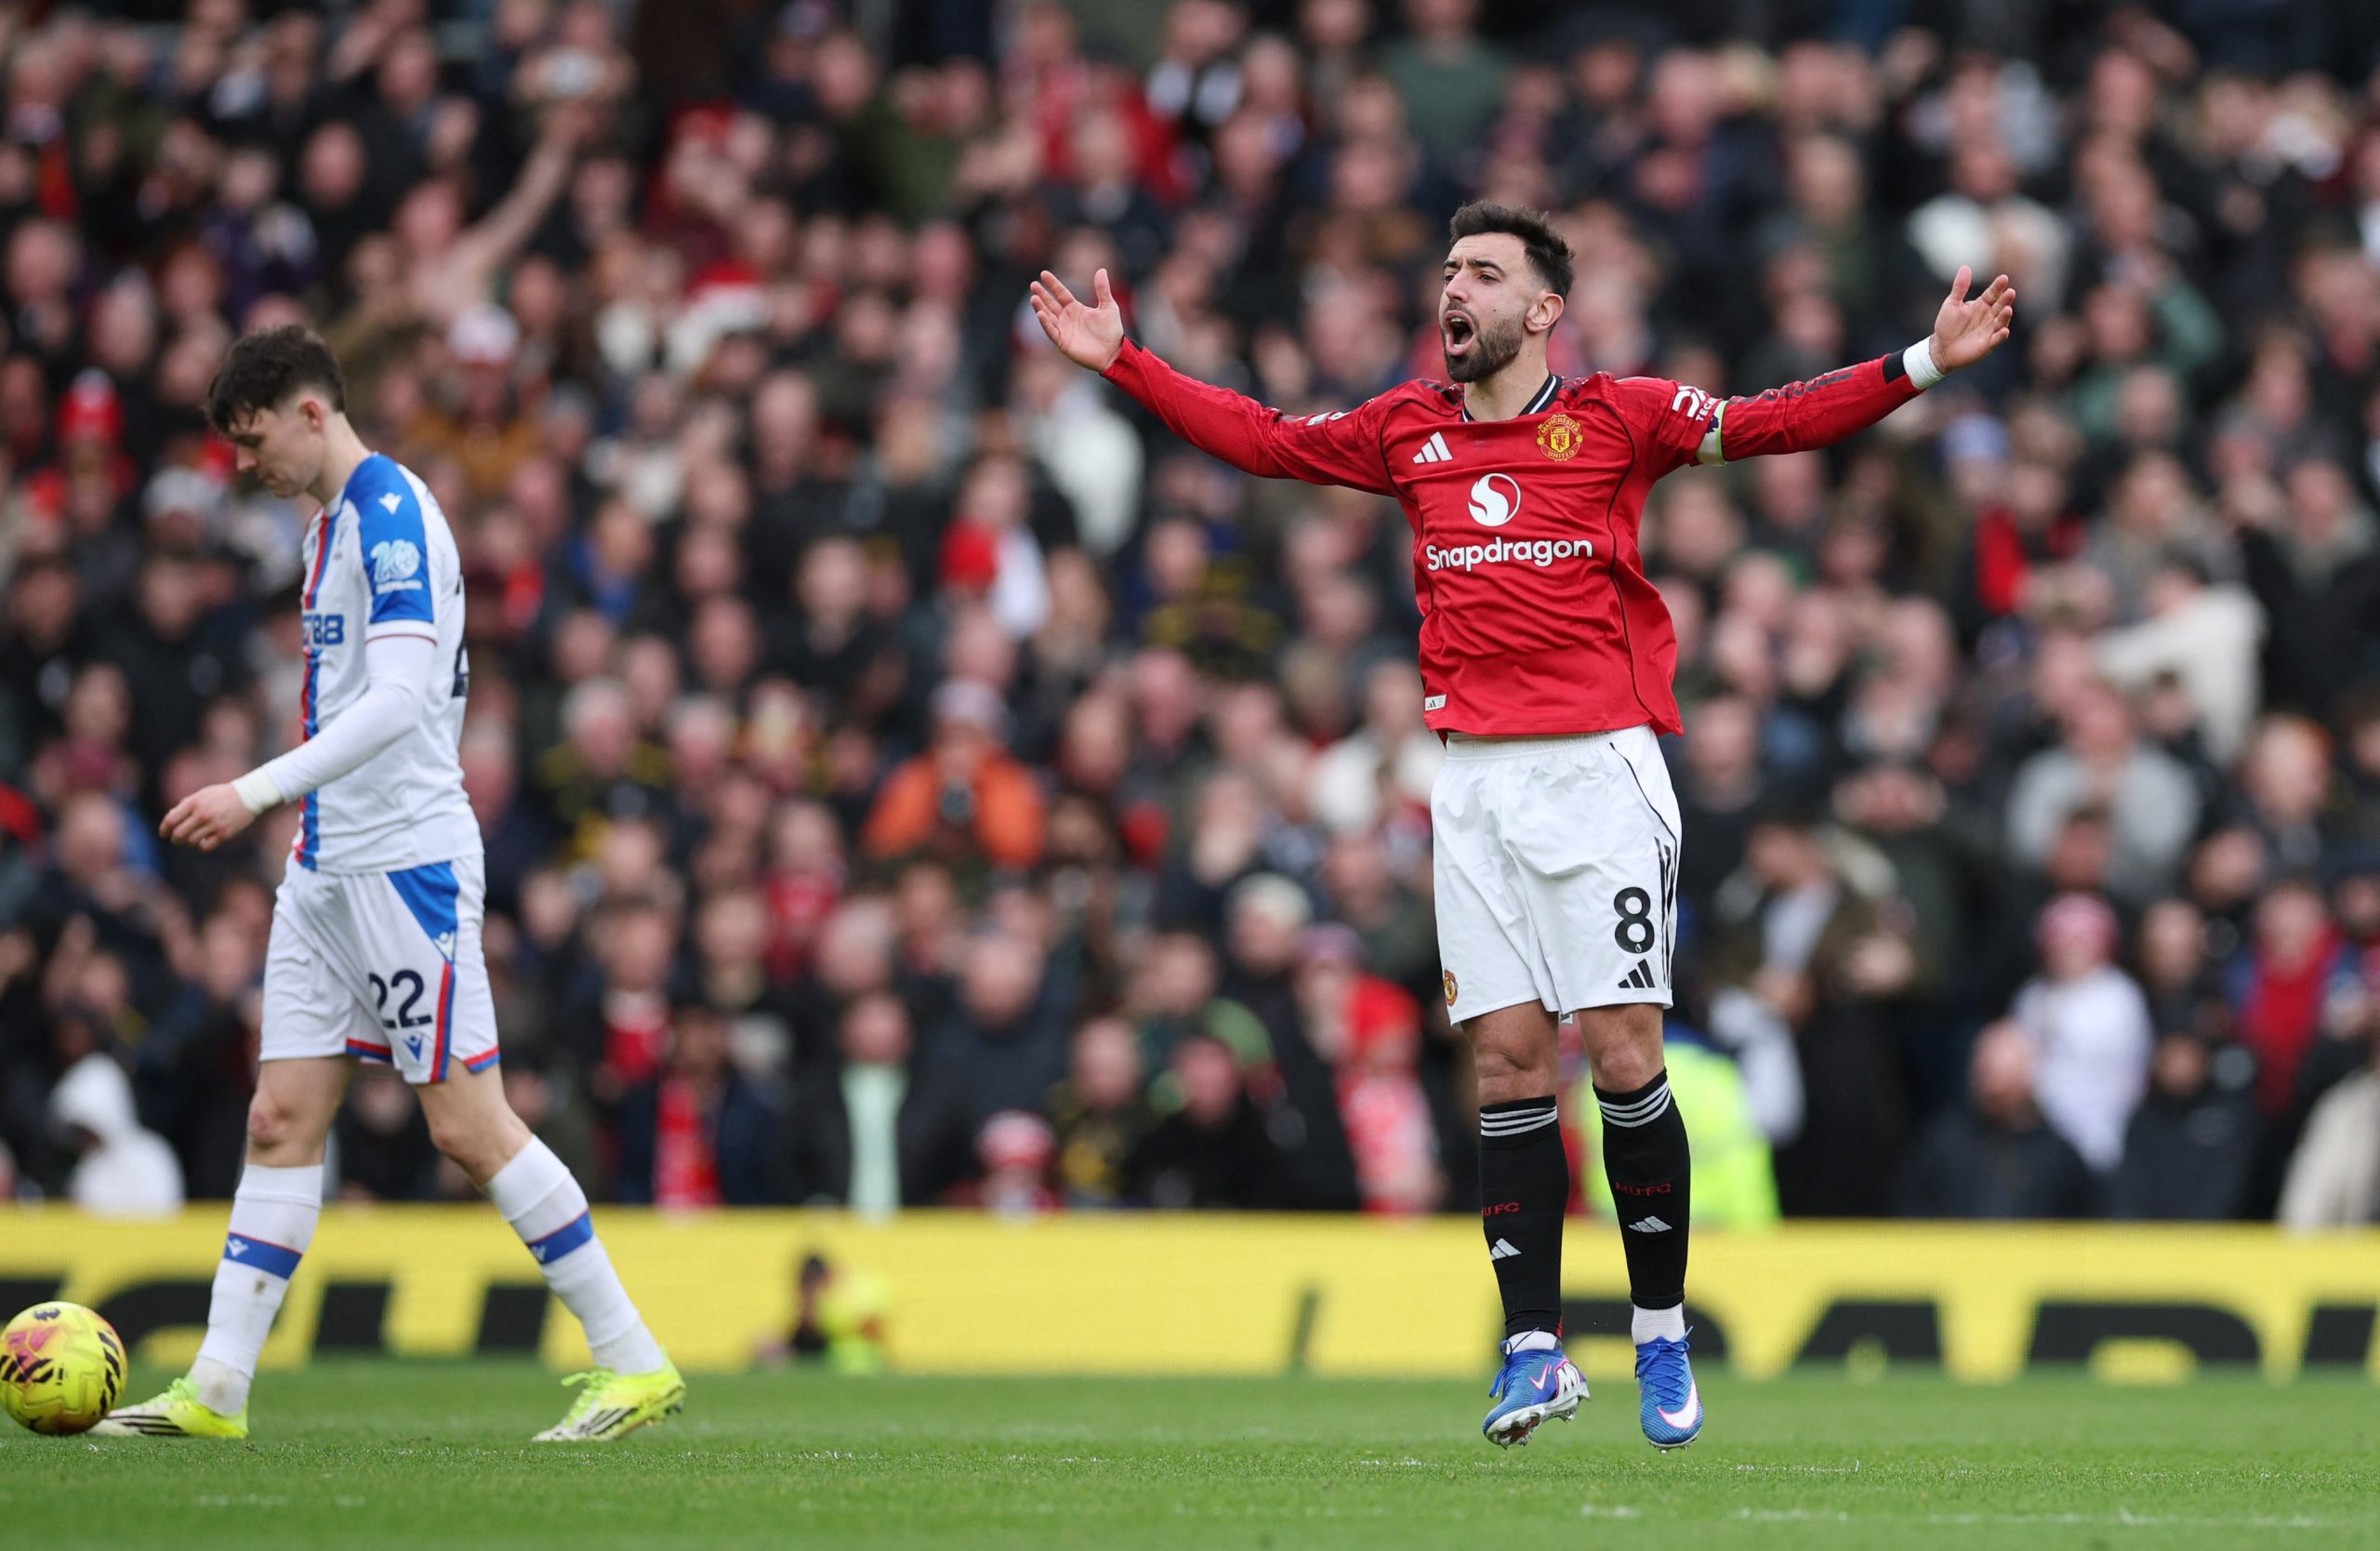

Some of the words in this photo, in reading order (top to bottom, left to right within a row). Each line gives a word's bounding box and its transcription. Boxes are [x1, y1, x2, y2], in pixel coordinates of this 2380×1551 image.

[1425, 536, 1593, 572] Snapdragon
[1614, 886, 1656, 954] 8
[368, 969, 432, 1029] 22
[1481, 1201, 1520, 1217] UFC
